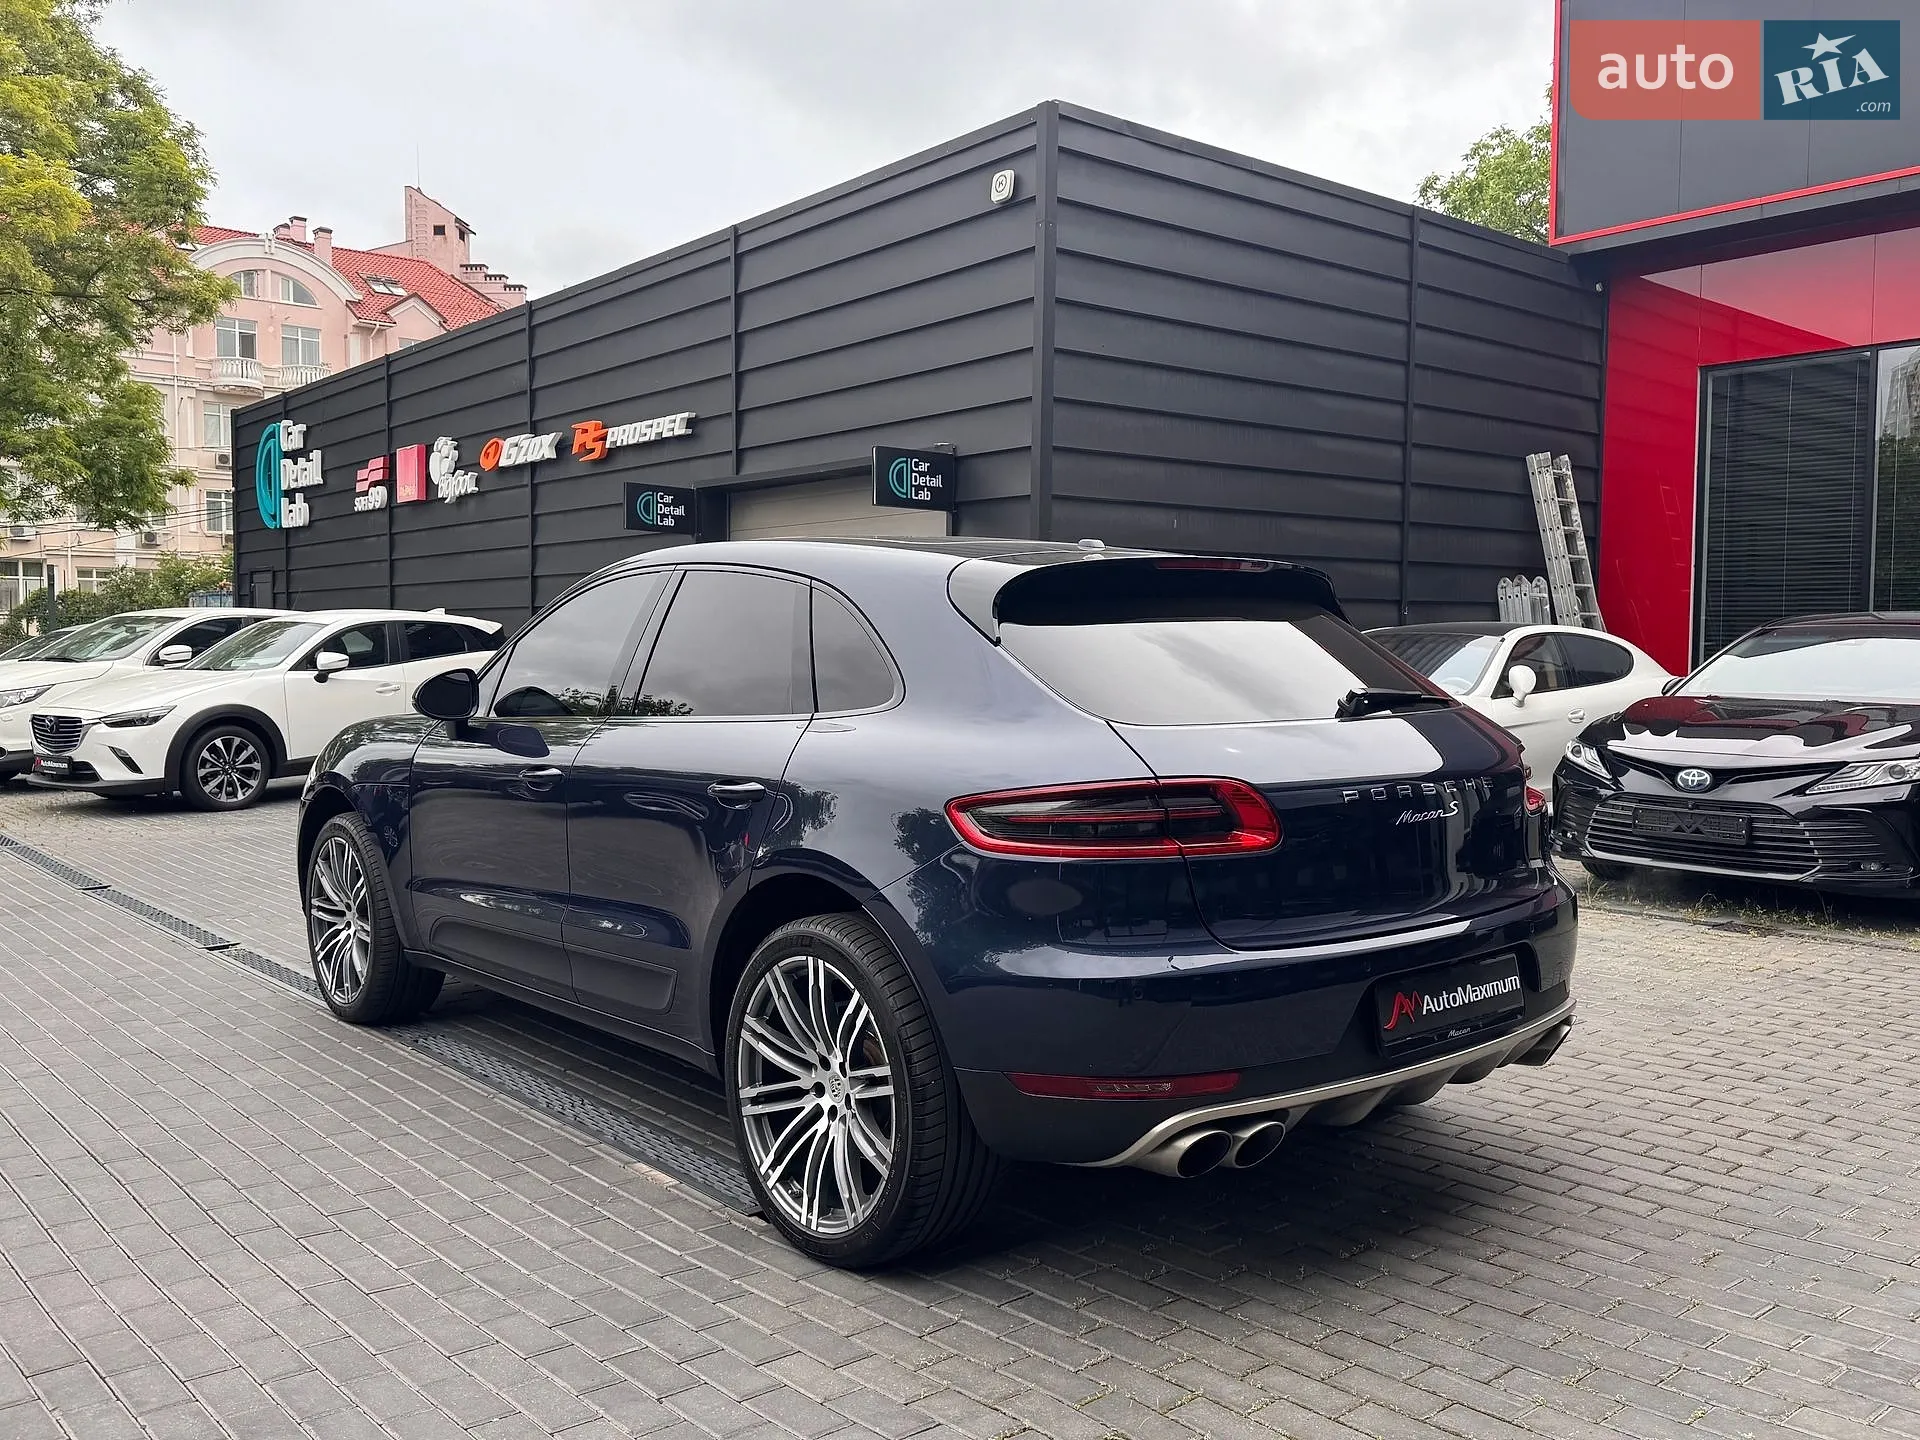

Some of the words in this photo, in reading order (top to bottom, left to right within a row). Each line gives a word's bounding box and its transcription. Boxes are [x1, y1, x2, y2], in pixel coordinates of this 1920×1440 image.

[280, 419, 307, 452] Car
[605, 411, 696, 449] PROSPEC
[280, 449, 324, 491] Detail
[911, 458, 930, 472] Car
[911, 472, 943, 488] Detail
[657, 492, 674, 503] Car
[911, 487, 931, 501] Lab
[281, 492, 310, 528] Lab
[657, 503, 686, 516] Detail
[657, 515, 675, 526] Lab
[1342, 776, 1494, 804] PORSCHE
[1395, 809, 1443, 826] Macan
[1422, 975, 1521, 1016] AutoMaximum
[1447, 1027, 1471, 1039] Macan
